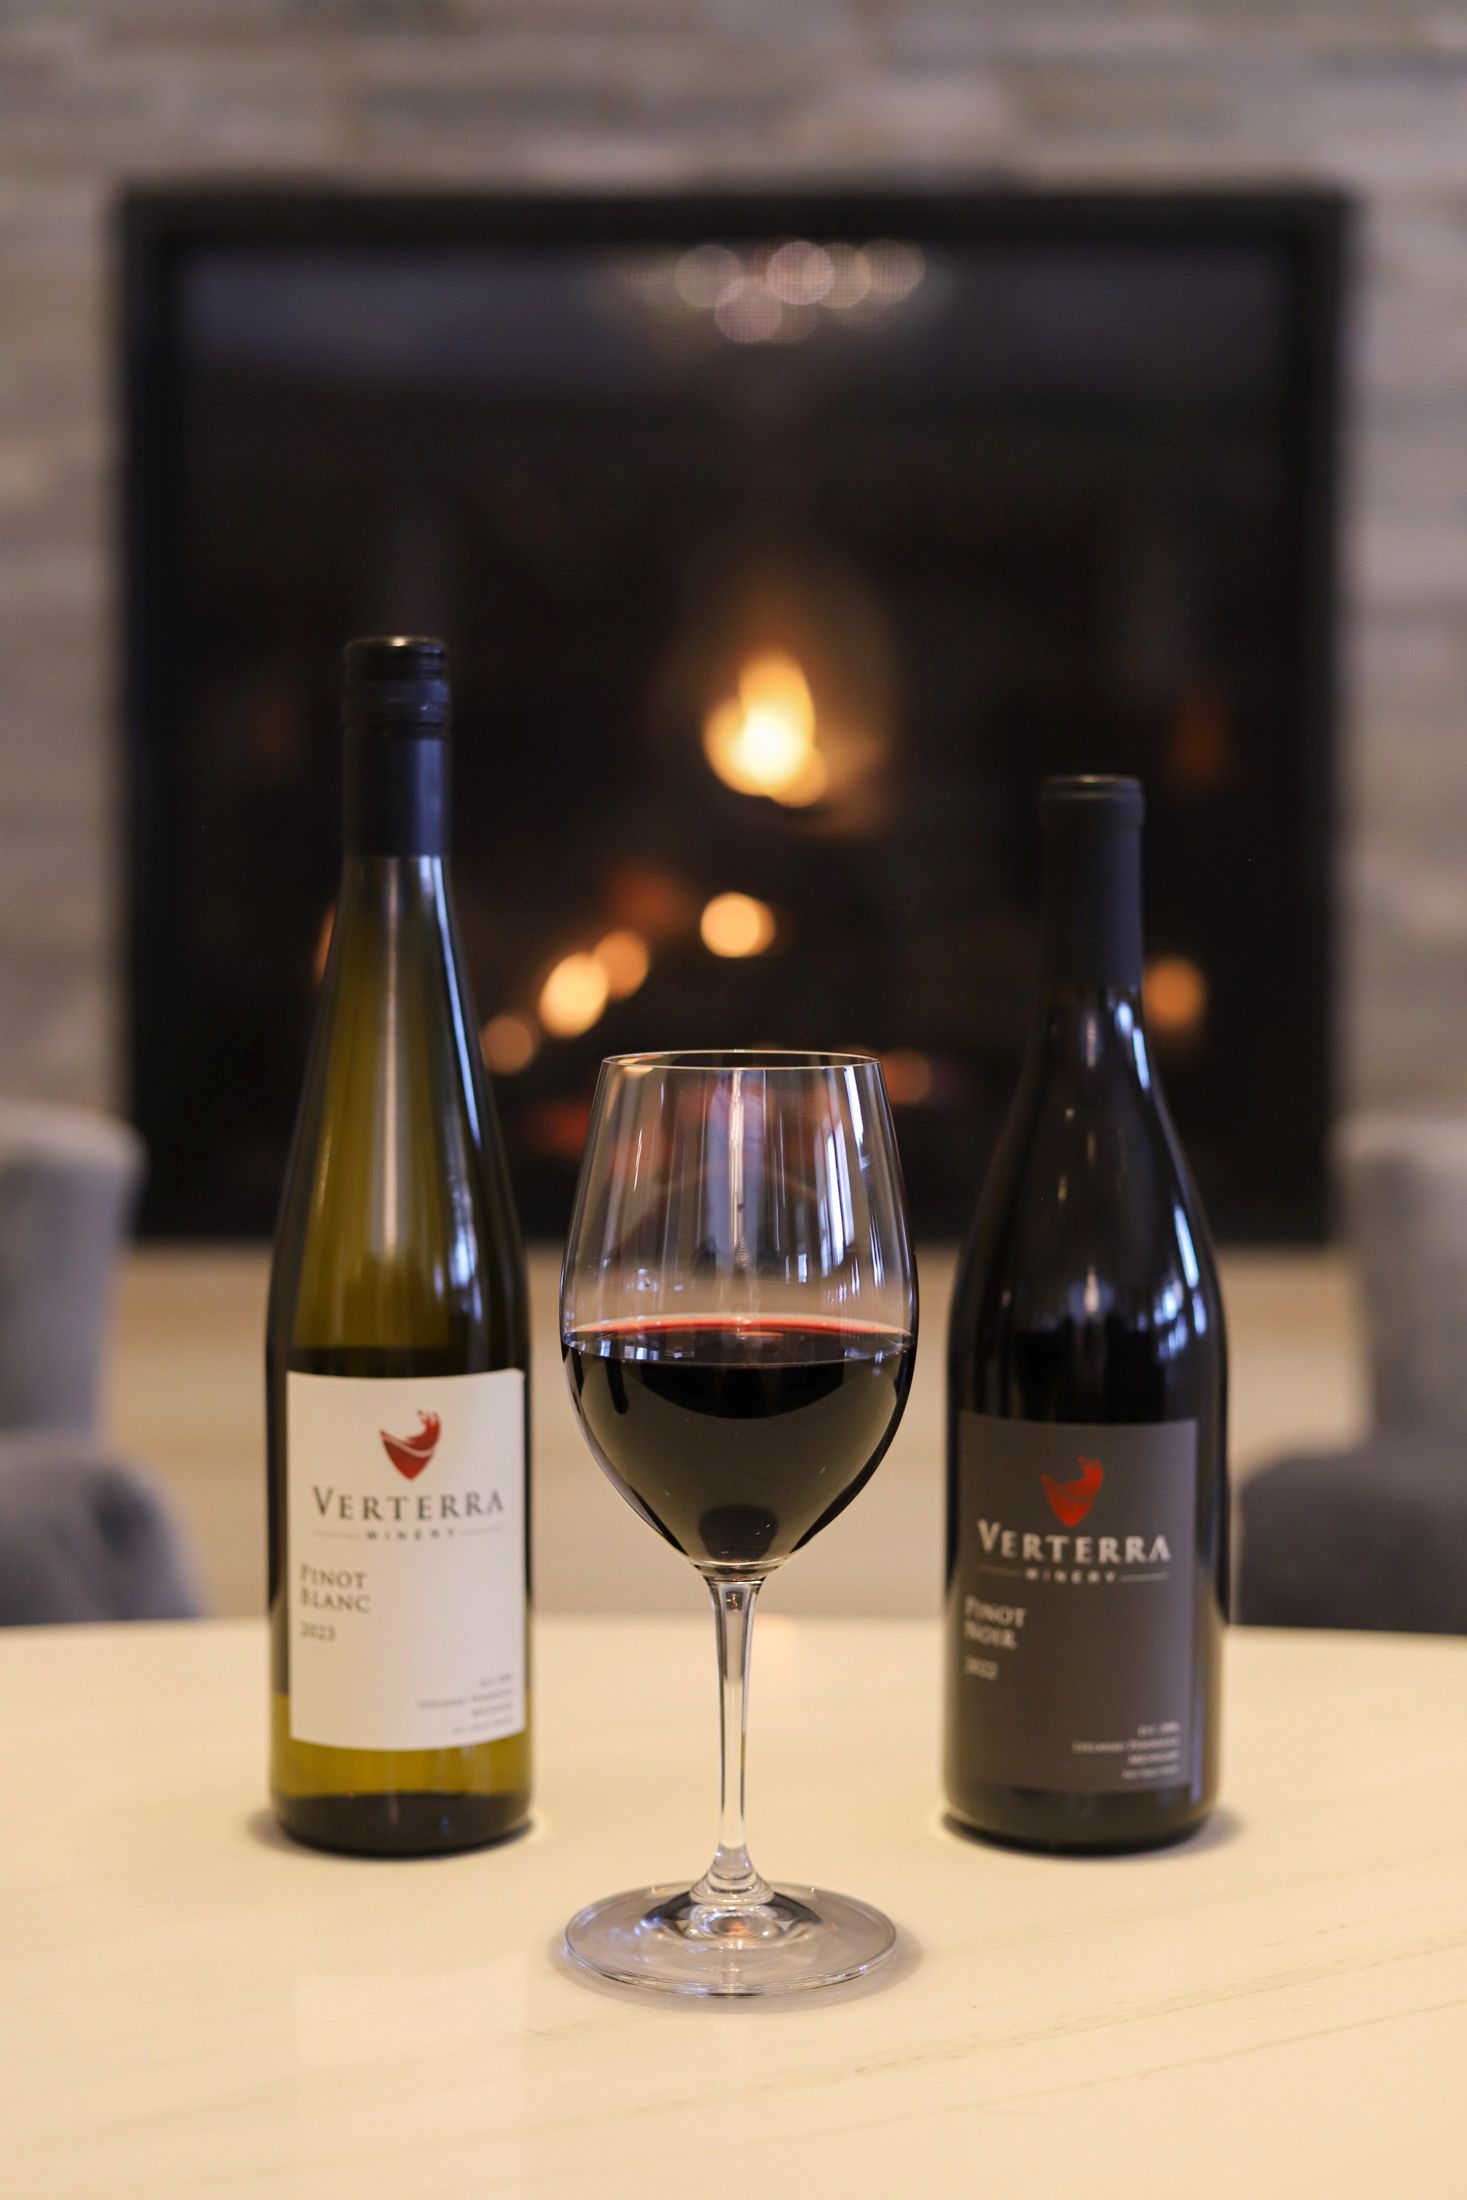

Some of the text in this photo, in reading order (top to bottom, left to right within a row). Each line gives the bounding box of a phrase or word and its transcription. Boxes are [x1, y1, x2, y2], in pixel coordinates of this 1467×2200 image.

[313, 1485, 504, 1521] VERTERRA
[365, 1528, 454, 1541] WINERY
[977, 1519, 1171, 1564] VERTERRA
[300, 1563, 367, 1589] PINOT
[300, 1588, 371, 1613] BLANC
